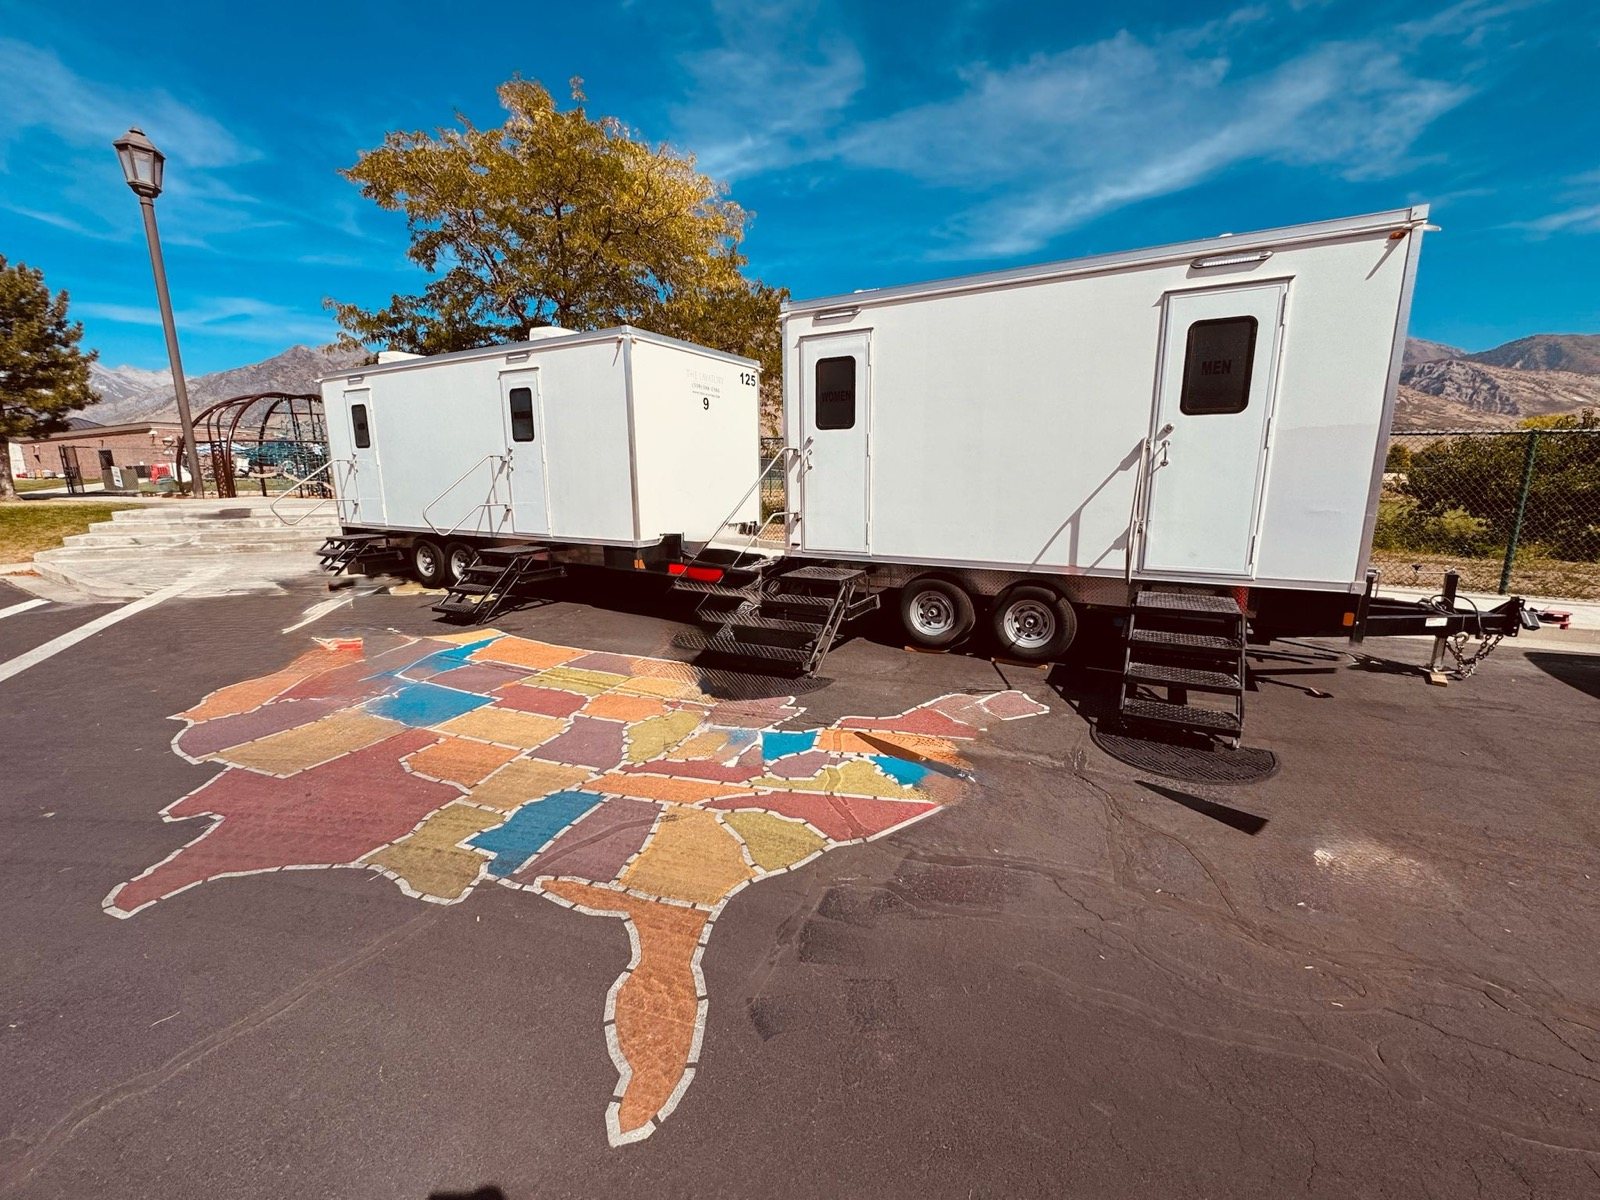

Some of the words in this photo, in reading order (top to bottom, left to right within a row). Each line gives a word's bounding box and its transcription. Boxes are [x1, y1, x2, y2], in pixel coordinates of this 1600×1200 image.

[1201, 359, 1232, 376] MEN
[740, 372, 756, 386] 125
[821, 390, 852, 402] WOMEN
[703, 397, 709, 410] 9
